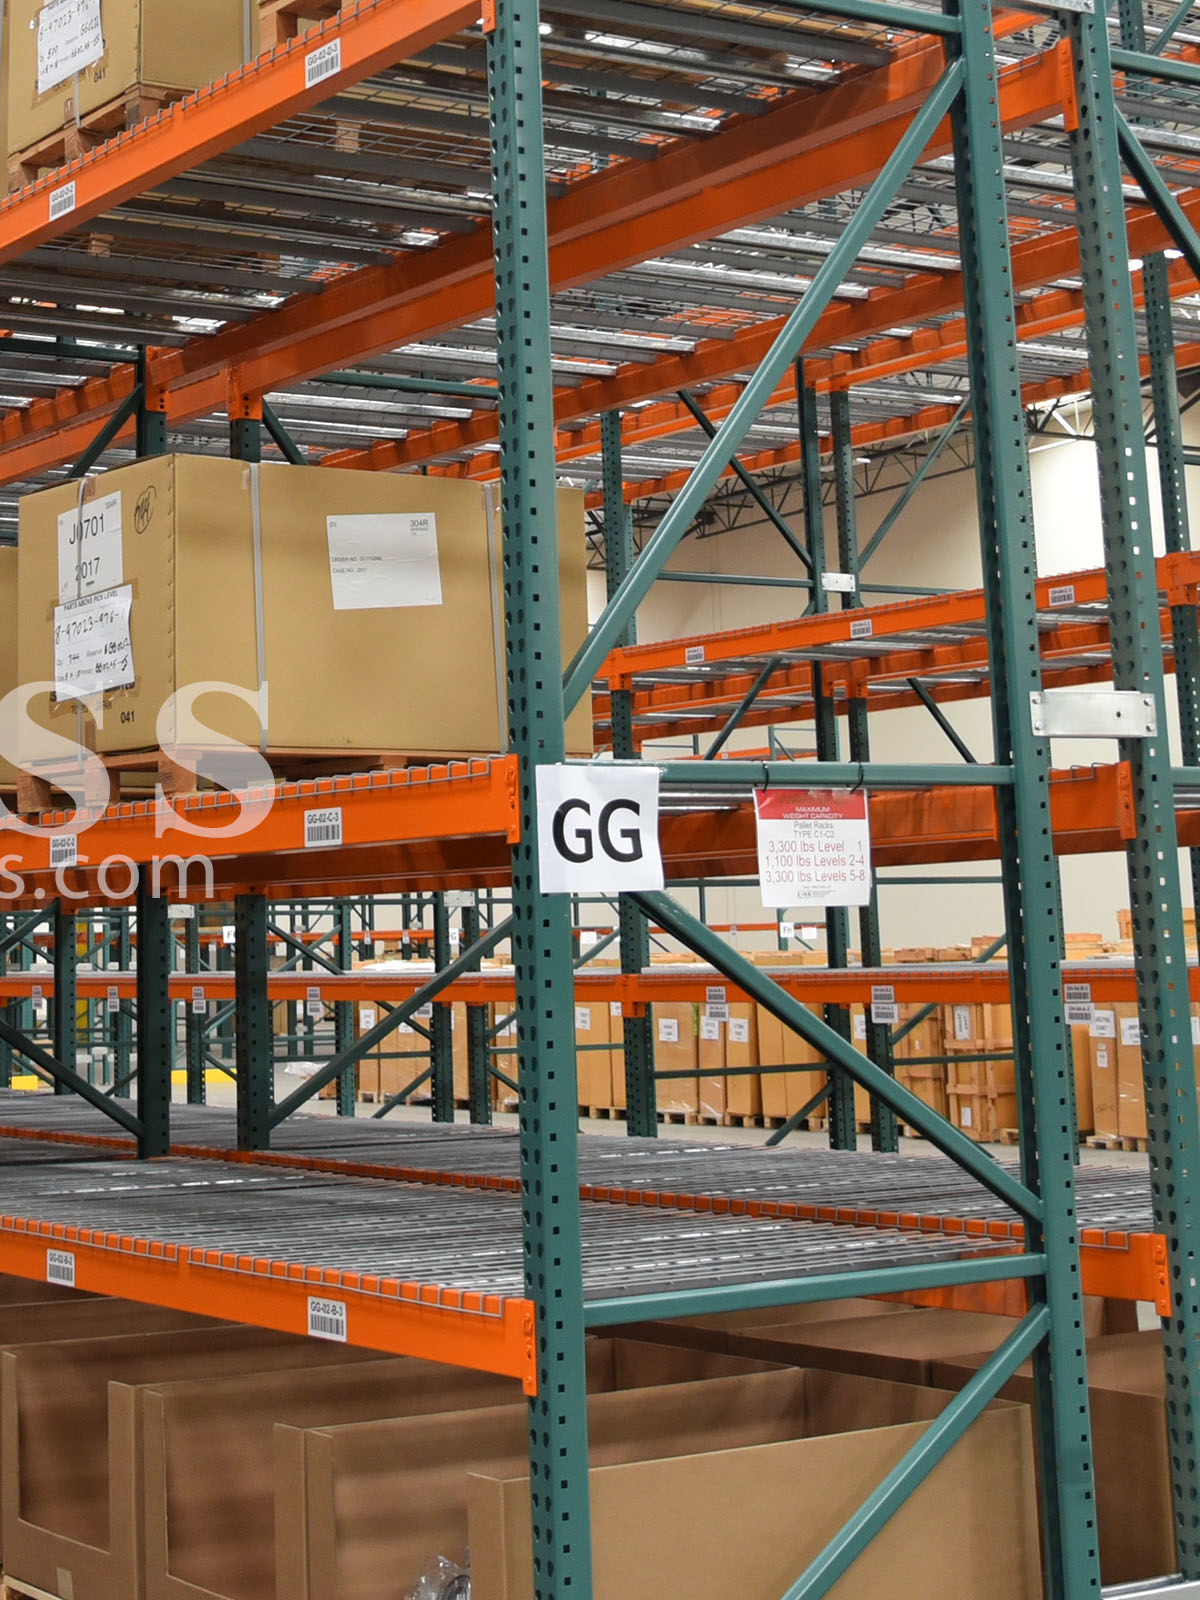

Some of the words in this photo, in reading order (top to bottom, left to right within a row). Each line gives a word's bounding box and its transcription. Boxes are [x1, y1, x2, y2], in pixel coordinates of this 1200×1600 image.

[307, 43, 338, 66] GG-02-D-3
[69, 513, 104, 545] J0701
[75, 557, 100, 581] 2017
[120, 711, 135, 723] 041
[307, 812, 339, 824] GG-02-C-3
[793, 821, 813, 829] Pallet
[813, 821, 834, 829] Racks
[552, 798, 643, 863] GG
[794, 830, 812, 838] TYPE
[814, 830, 834, 838] C1-C2
[769, 841, 797, 854] 3,300
[800, 841, 815, 852] lbs
[818, 841, 845, 852] Level
[857, 840, 862, 851] 1
[766, 855, 793, 868] 1,100
[796, 855, 811, 866] lbs
[814, 855, 846, 866] Levels
[849, 855, 865, 866] 2-4
[765, 870, 794, 884] 3,300
[797, 871, 812, 882] lbs
[815, 870, 847, 882] Levels
[850, 869, 866, 881] 5-8
[310, 1301, 343, 1317] GG-02-B-3
